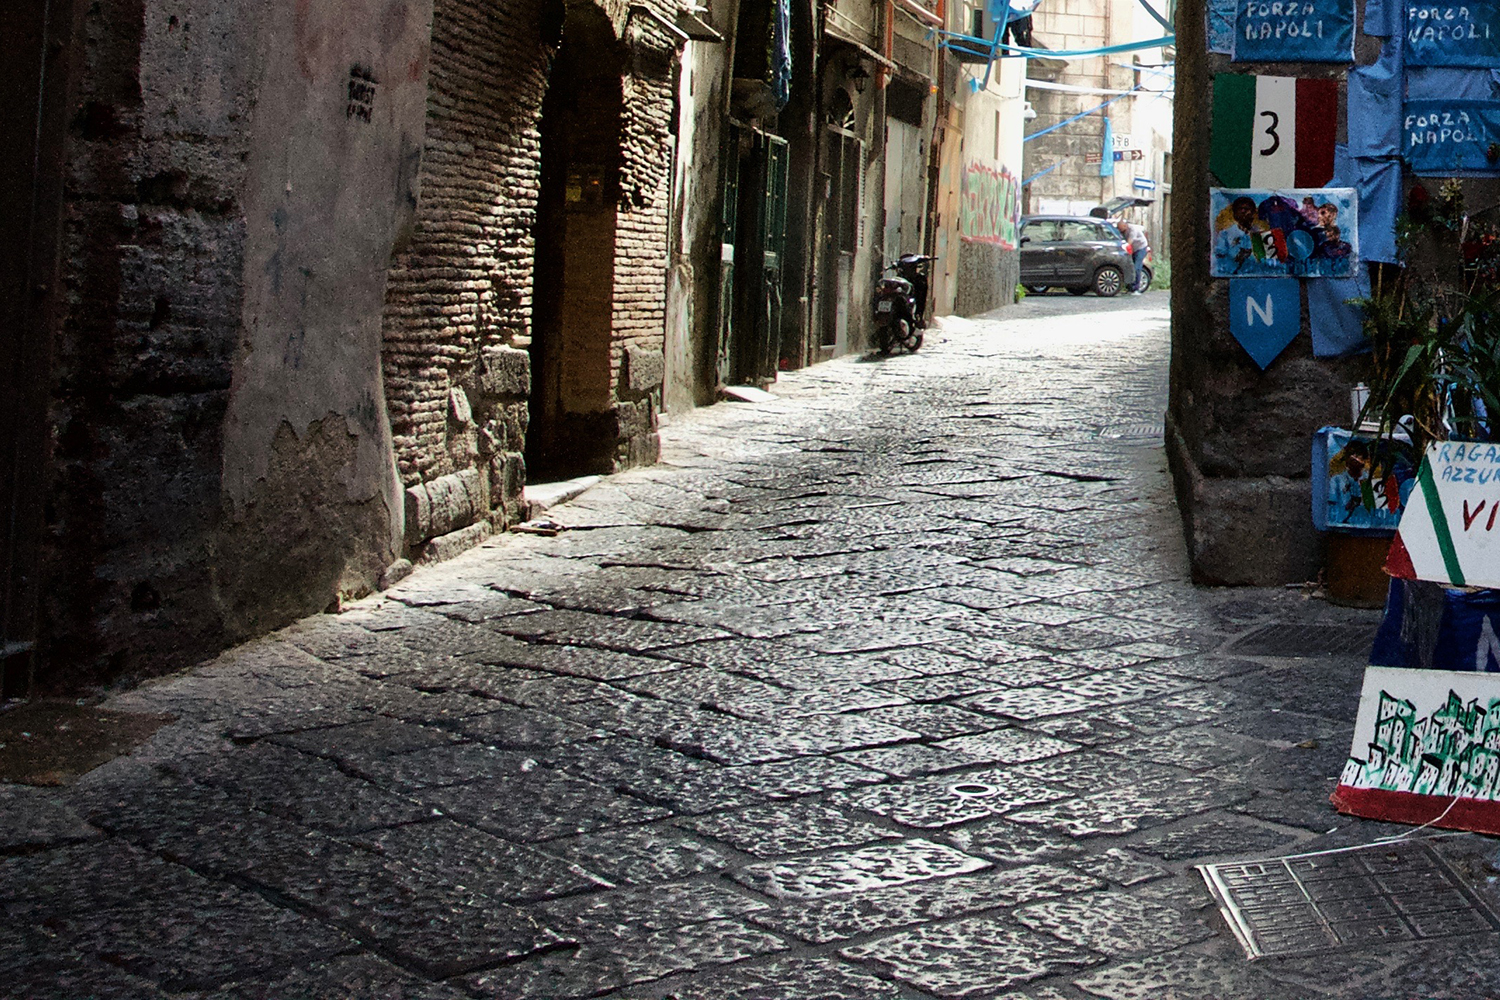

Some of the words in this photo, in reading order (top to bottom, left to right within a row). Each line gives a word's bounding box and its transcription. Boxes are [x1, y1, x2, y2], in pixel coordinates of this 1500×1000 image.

[1246, 1, 1315, 18] FORZA
[1246, 19, 1324, 40] NAPOLI
[1407, 23, 1491, 44] NAPOLI
[1404, 111, 1471, 130] FORZA
[1260, 110, 1281, 157] 3
[1411, 124, 1487, 147] NAPOLI
[1247, 293, 1274, 327] N
